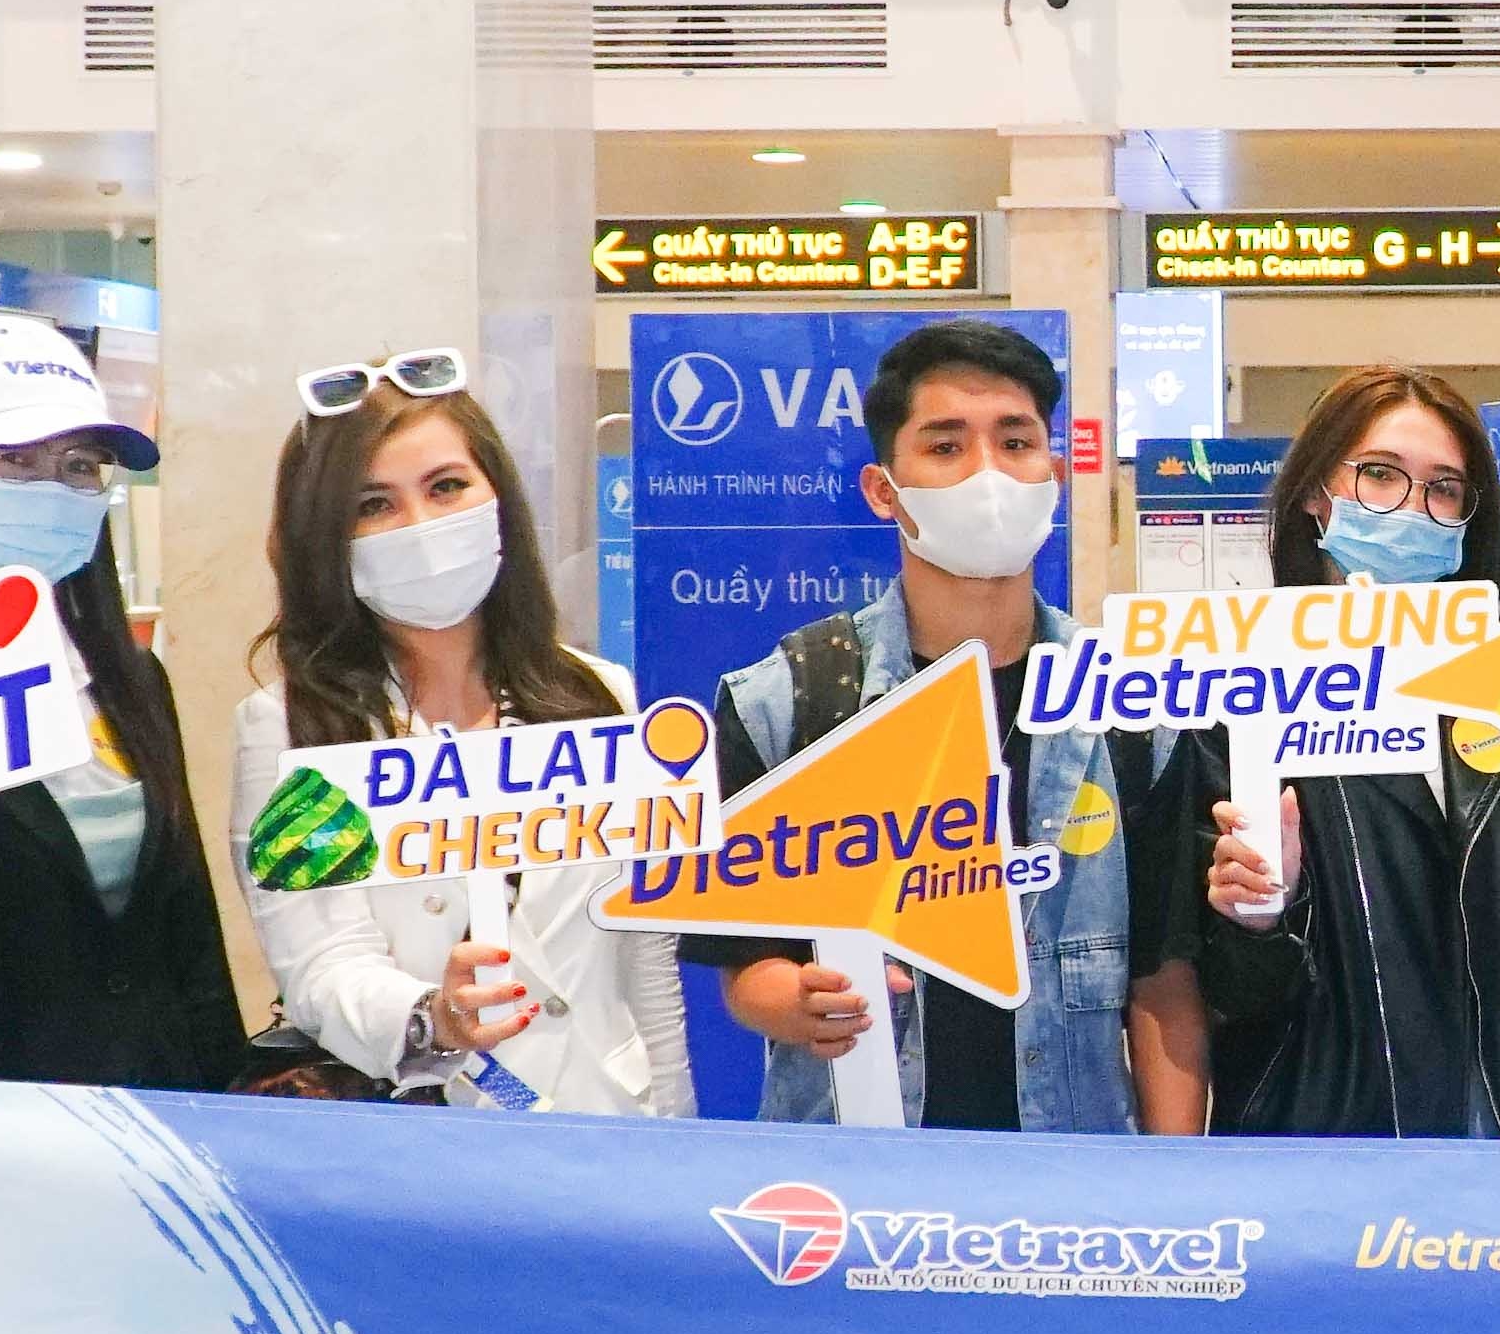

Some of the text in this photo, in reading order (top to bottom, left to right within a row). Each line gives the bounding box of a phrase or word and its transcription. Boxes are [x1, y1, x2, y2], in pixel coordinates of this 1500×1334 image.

[726, 225, 790, 258] THỦ
[793, 232, 844, 260] TỤC
[867, 220, 969, 254] A-B-C
[1234, 219, 1291, 251] THỦ
[1294, 225, 1351, 254] TỤC
[1373, 231, 1407, 266] G
[1439, 230, 1471, 265] H
[652, 256, 964, 288] Check-in Counters D-E-F
[1155, 254, 1366, 278] Check-in Counters
[648, 467, 843, 496] HÀNH TRÌNH NGẮN
[670, 565, 846, 612] Quầy thủ
[1122, 573, 1490, 658] BAY CÙNG
[1029, 638, 1385, 724] Vietravel
[364, 723, 636, 808] ĐÀ LẠT
[1274, 720, 1427, 765] Airlines
[384, 792, 705, 879] CHECK-IN
[894, 852, 1052, 914] Airlines
[850, 1211, 1248, 1276] Vietravel
[930, 1270, 988, 1290] CHỨC
[991, 1275, 1020, 1291] DU
[1025, 1276, 1072, 1295] LỊCH
[1077, 1275, 1160, 1294] CHUYÊN
[1164, 1278, 1243, 1301] NGHIỆP
